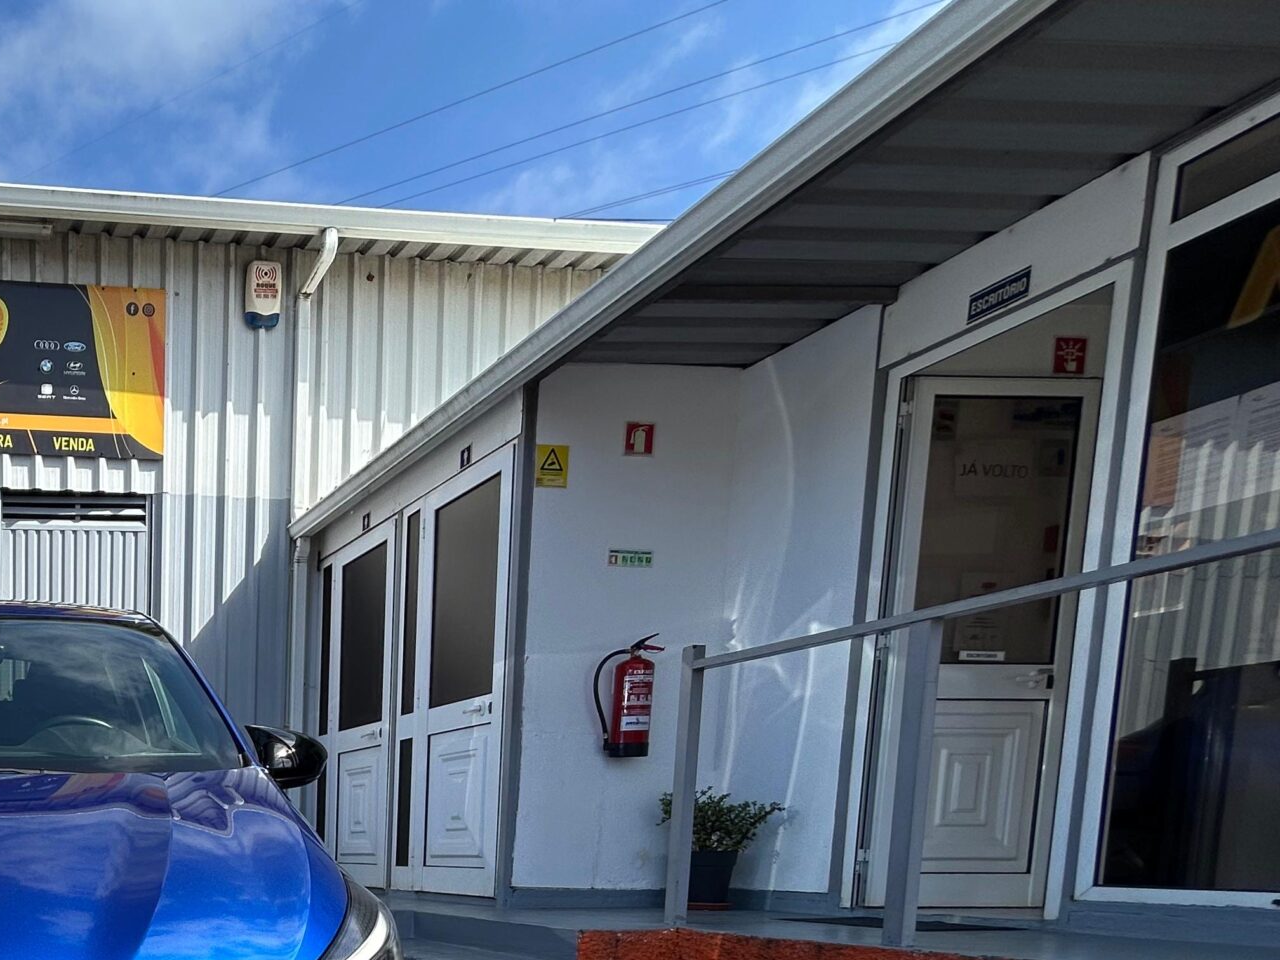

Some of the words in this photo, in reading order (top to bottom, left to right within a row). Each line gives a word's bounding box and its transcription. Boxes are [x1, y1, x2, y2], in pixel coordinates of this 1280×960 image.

[970, 277, 1027, 315] ESCRITÓRIO
[52, 436, 95, 452] VENDA
[959, 459, 977, 477] JÁ
[982, 463, 1030, 479] VOLTO
